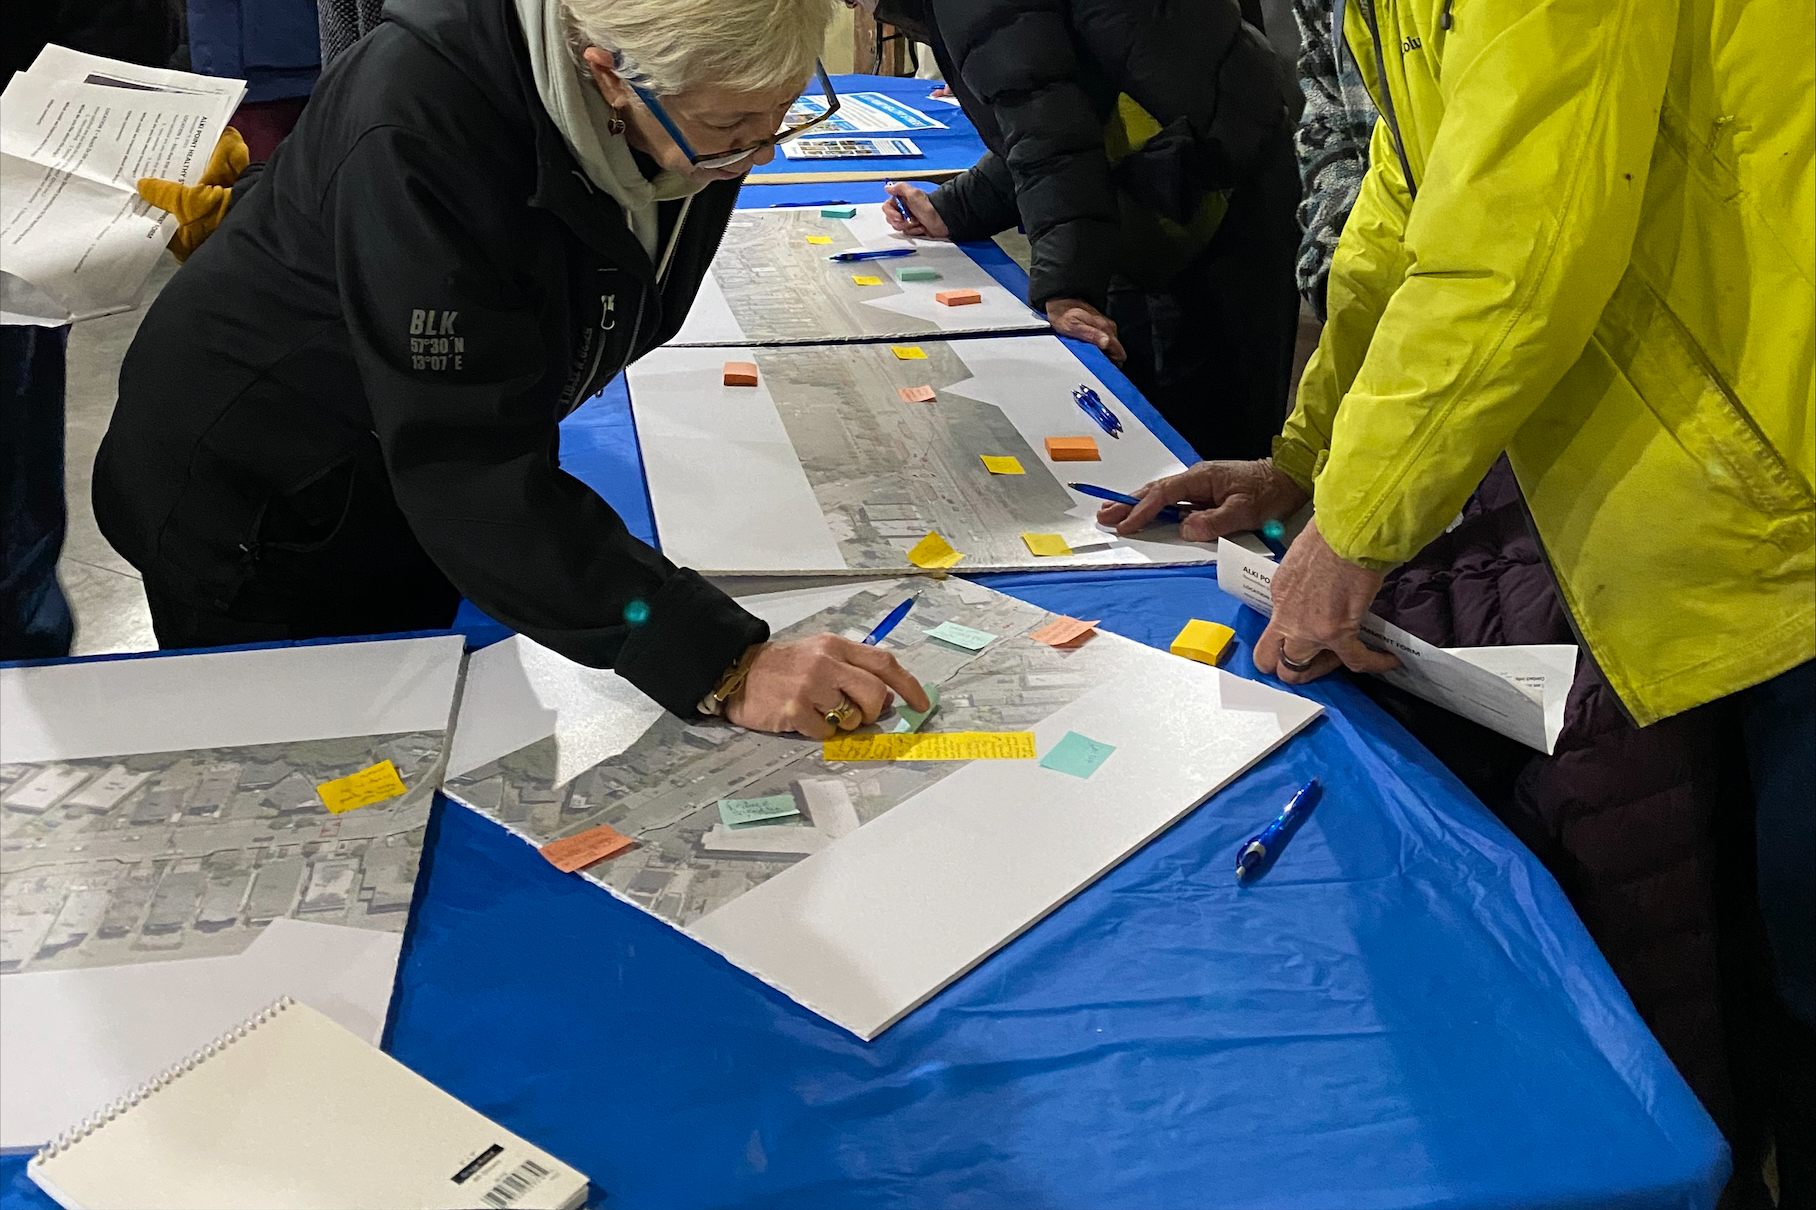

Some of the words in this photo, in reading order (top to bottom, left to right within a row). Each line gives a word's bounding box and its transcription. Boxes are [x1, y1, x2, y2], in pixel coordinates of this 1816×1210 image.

[1402, 36, 1421, 52] olu
[198, 116, 207, 128] ALKI
[190, 130, 202, 148] POINT
[181, 149, 194, 177] HEALTHY
[410, 308, 458, 335] BLK
[1243, 566, 1258, 578] ALKI
